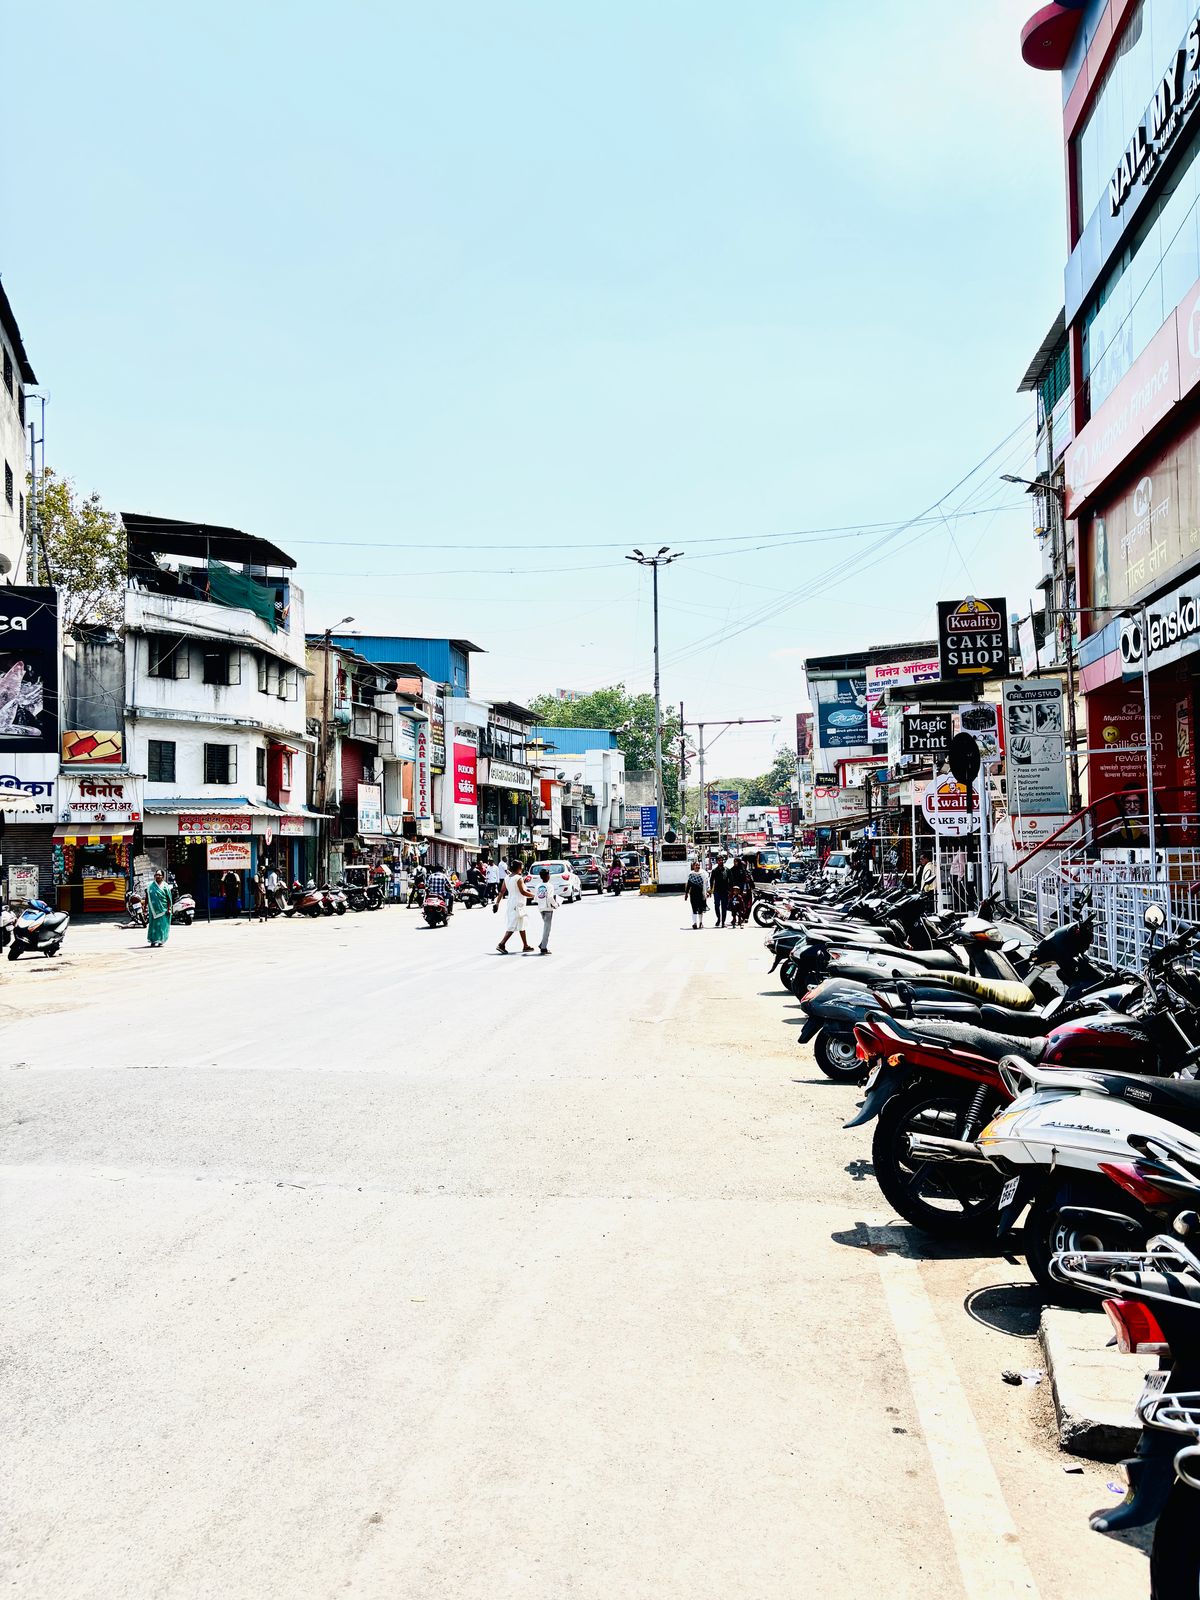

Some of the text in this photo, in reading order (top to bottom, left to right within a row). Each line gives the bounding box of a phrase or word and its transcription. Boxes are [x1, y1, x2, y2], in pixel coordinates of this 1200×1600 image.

[1109, 127, 1146, 214] NAIL
[1150, 49, 1180, 140] MY
[951, 614, 998, 629] Kwality
[946, 634, 1003, 650] CAKE
[948, 651, 1003, 666] SHOP
[1009, 692, 1025, 700] NAIL
[1037, 690, 1058, 698] STYLE
[909, 716, 947, 733] Magic
[909, 733, 947, 749] Print
[418, 732, 427, 817] AMAR ELECTRICAL
[78, 779, 124, 799] विनोद
[69, 802, 99, 811] जनरल
[931, 796, 980, 808] Kwaliy
